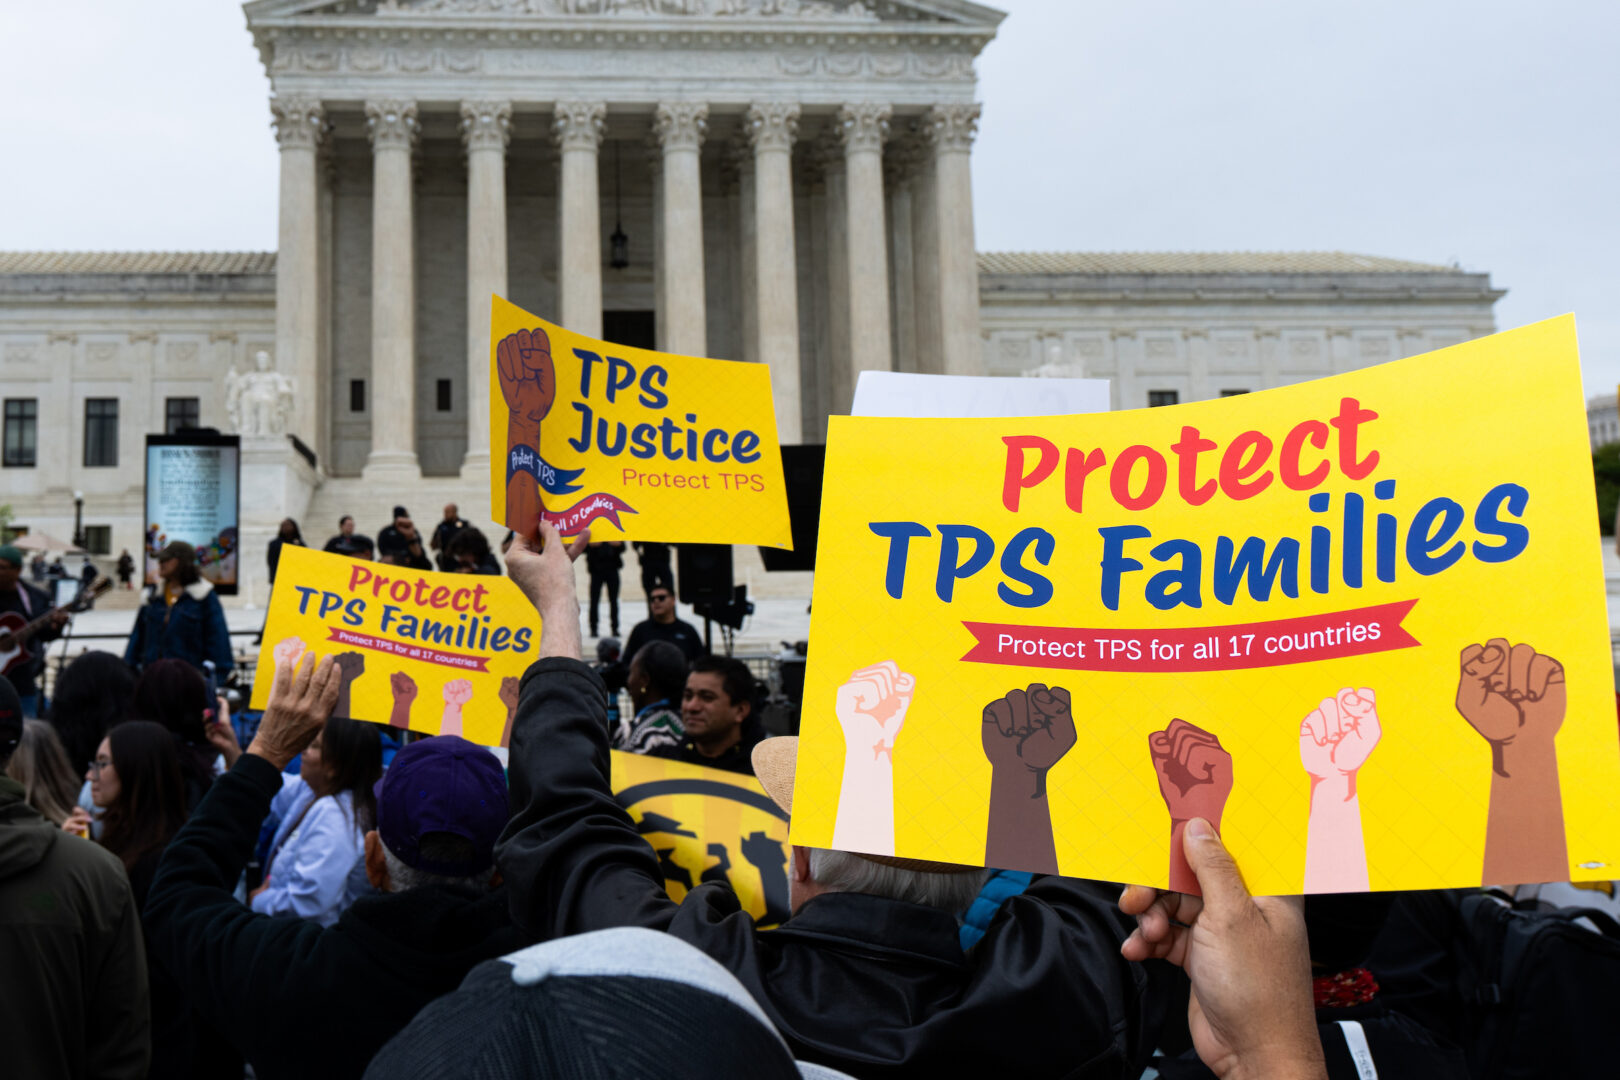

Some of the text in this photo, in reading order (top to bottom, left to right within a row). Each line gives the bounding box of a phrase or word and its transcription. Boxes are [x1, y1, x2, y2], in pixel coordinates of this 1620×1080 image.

[572, 347, 668, 410] TPS
[567, 400, 762, 464] Justice
[1000, 396, 1381, 514] Protect
[512, 448, 555, 485] Protect TPS
[622, 468, 766, 492] Protect TPS
[867, 478, 1530, 612] TPS Families
[348, 564, 490, 615] Protect
[294, 585, 533, 653] TPS Families
[998, 620, 1382, 661] Protect TPS for all 17 countries
[339, 631, 479, 668] Protect TPS for all 17 countries
